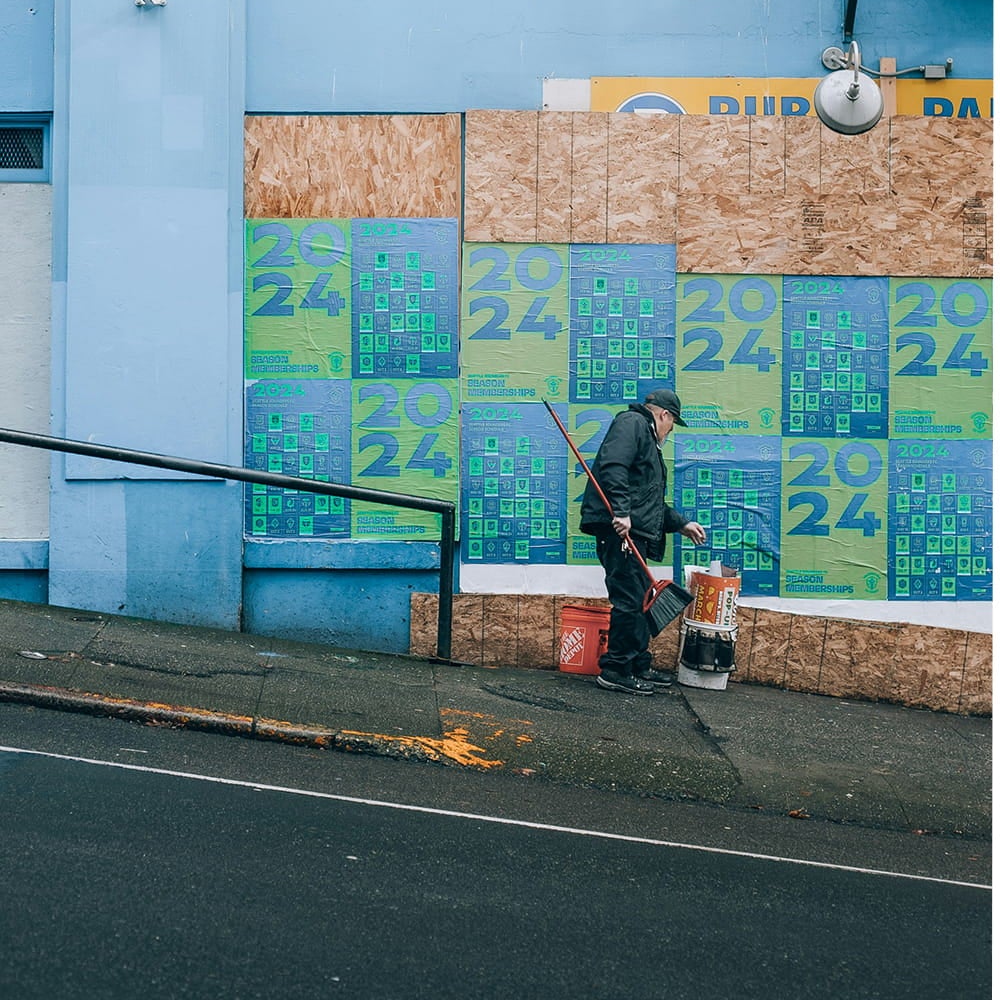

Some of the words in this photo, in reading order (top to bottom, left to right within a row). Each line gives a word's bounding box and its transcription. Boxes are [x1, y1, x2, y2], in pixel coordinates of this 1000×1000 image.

[360, 223, 411, 236] 2024
[252, 222, 347, 268] 20
[580, 248, 632, 261] 2024
[469, 246, 563, 292] 20
[251, 272, 346, 316] 24
[791, 281, 844, 294] 2024
[682, 278, 777, 323] 20
[896, 282, 989, 328] 20
[469, 296, 563, 340] 24
[683, 327, 776, 372] 24
[896, 332, 988, 377] 24
[251, 356, 288, 364] SEASON
[253, 383, 306, 397] 2024
[467, 379, 505, 387] SEASON
[358, 383, 451, 428] 20
[470, 408, 523, 420] 2024
[681, 411, 718, 419] SEASON
[895, 416, 932, 424] SEASON
[683, 440, 736, 453] 2024
[896, 444, 949, 457] 2024
[358, 432, 452, 478] 24
[788, 442, 883, 488] 20
[788, 492, 881, 537] 24
[572, 542, 596, 550] SEAS
[786, 575, 823, 583] SEASON
